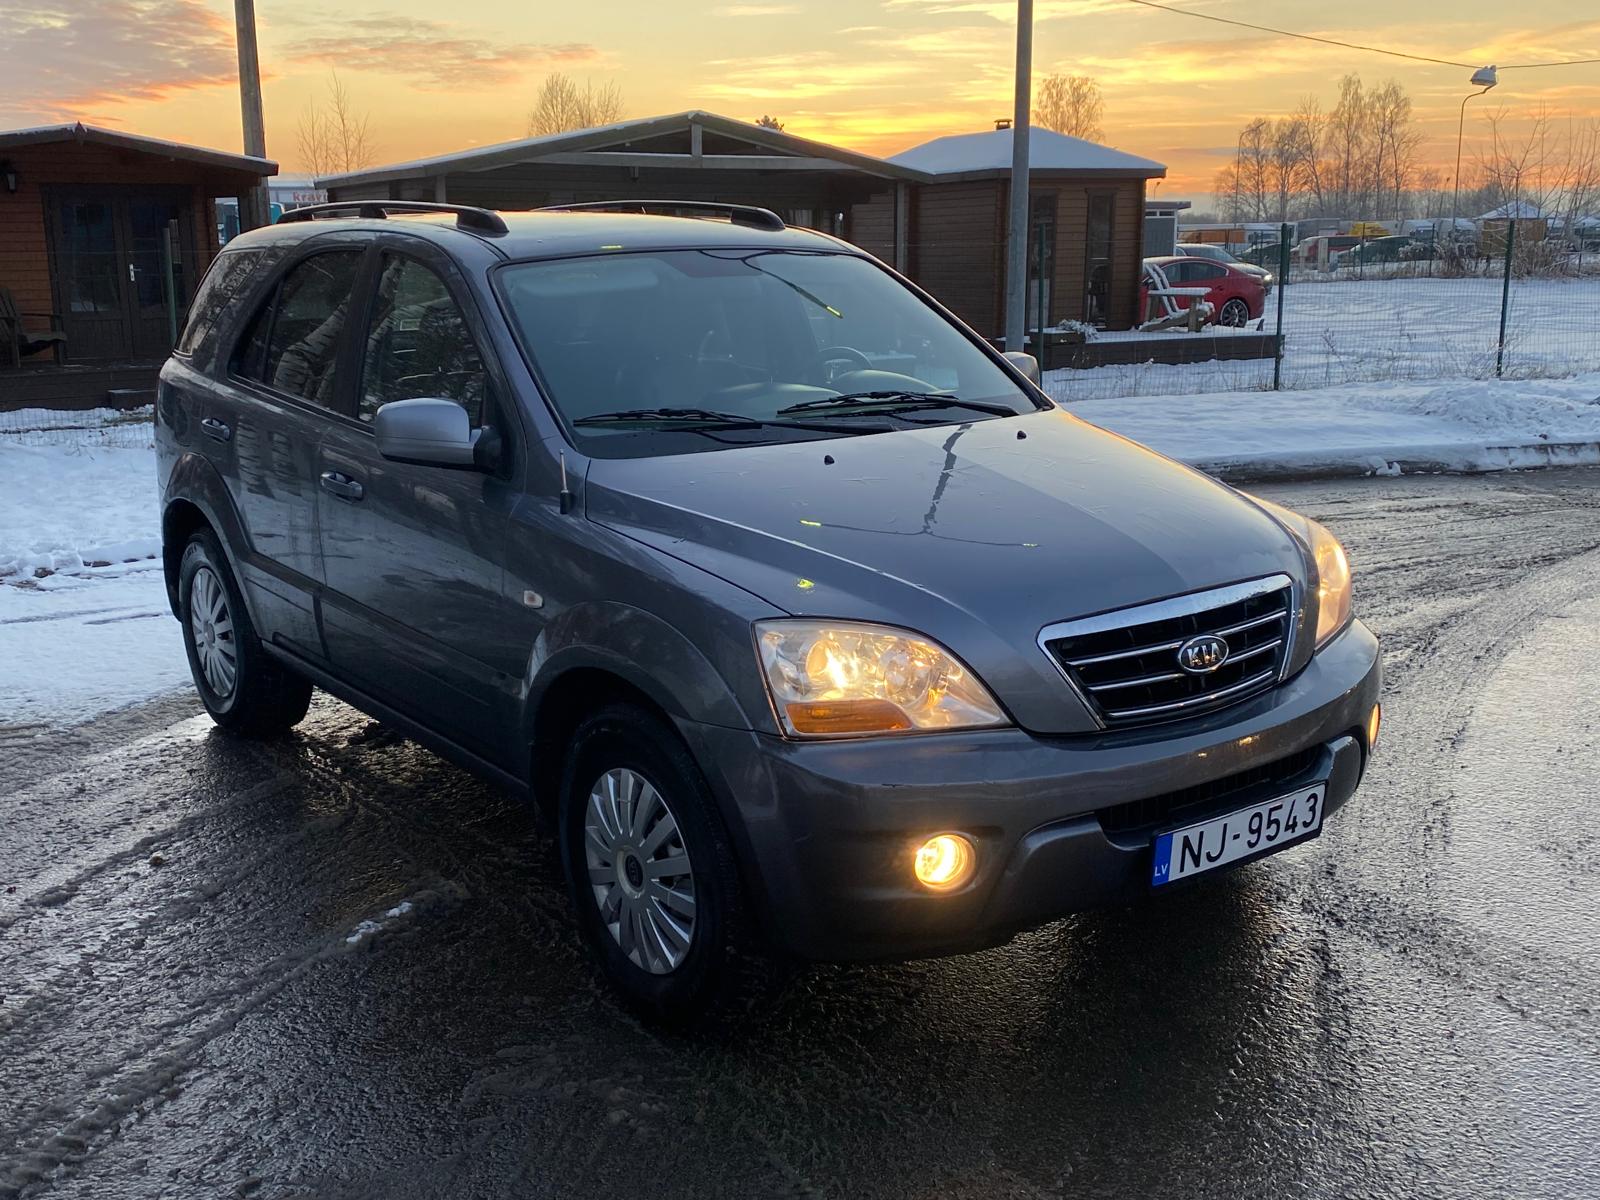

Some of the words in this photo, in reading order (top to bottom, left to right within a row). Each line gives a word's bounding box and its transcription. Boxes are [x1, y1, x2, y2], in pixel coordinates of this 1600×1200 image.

[1187, 642, 1224, 667] KIA
[1179, 792, 1319, 873] NJ-9543
[1154, 863, 1168, 877] LV
